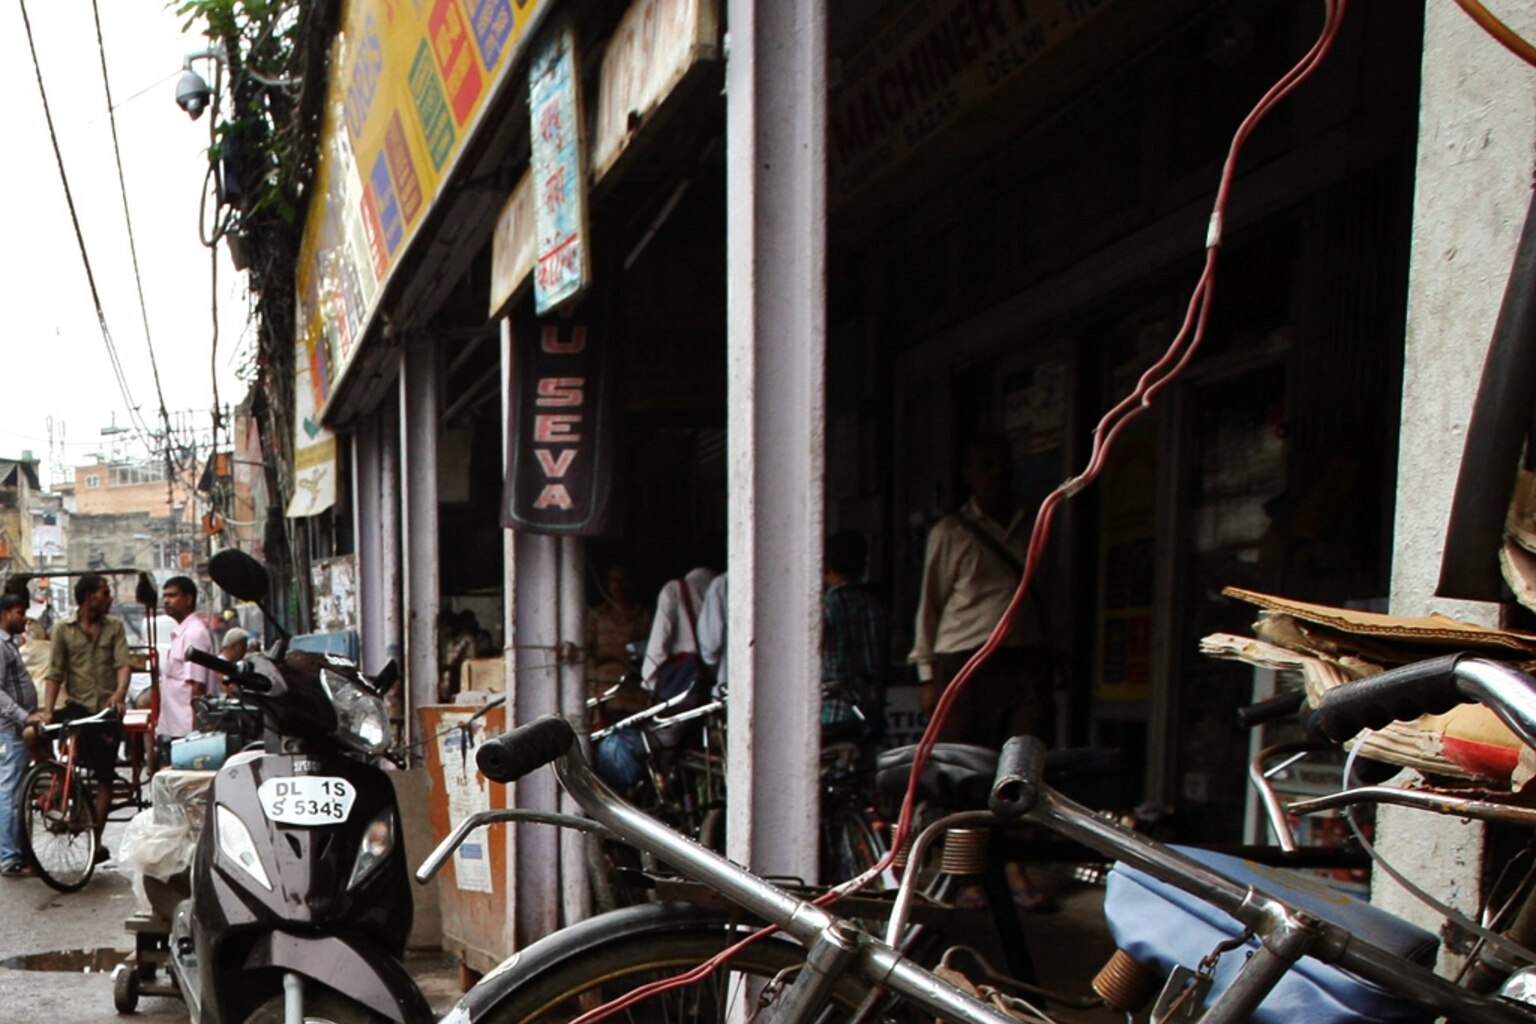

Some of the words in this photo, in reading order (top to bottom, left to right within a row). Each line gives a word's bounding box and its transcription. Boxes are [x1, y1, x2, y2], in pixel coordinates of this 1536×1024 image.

[533, 377, 586, 509] SEVA
[275, 781, 303, 797] DL
[321, 780, 346, 797] 1S
[271, 800, 285, 816] S
[294, 799, 344, 819] 5345
